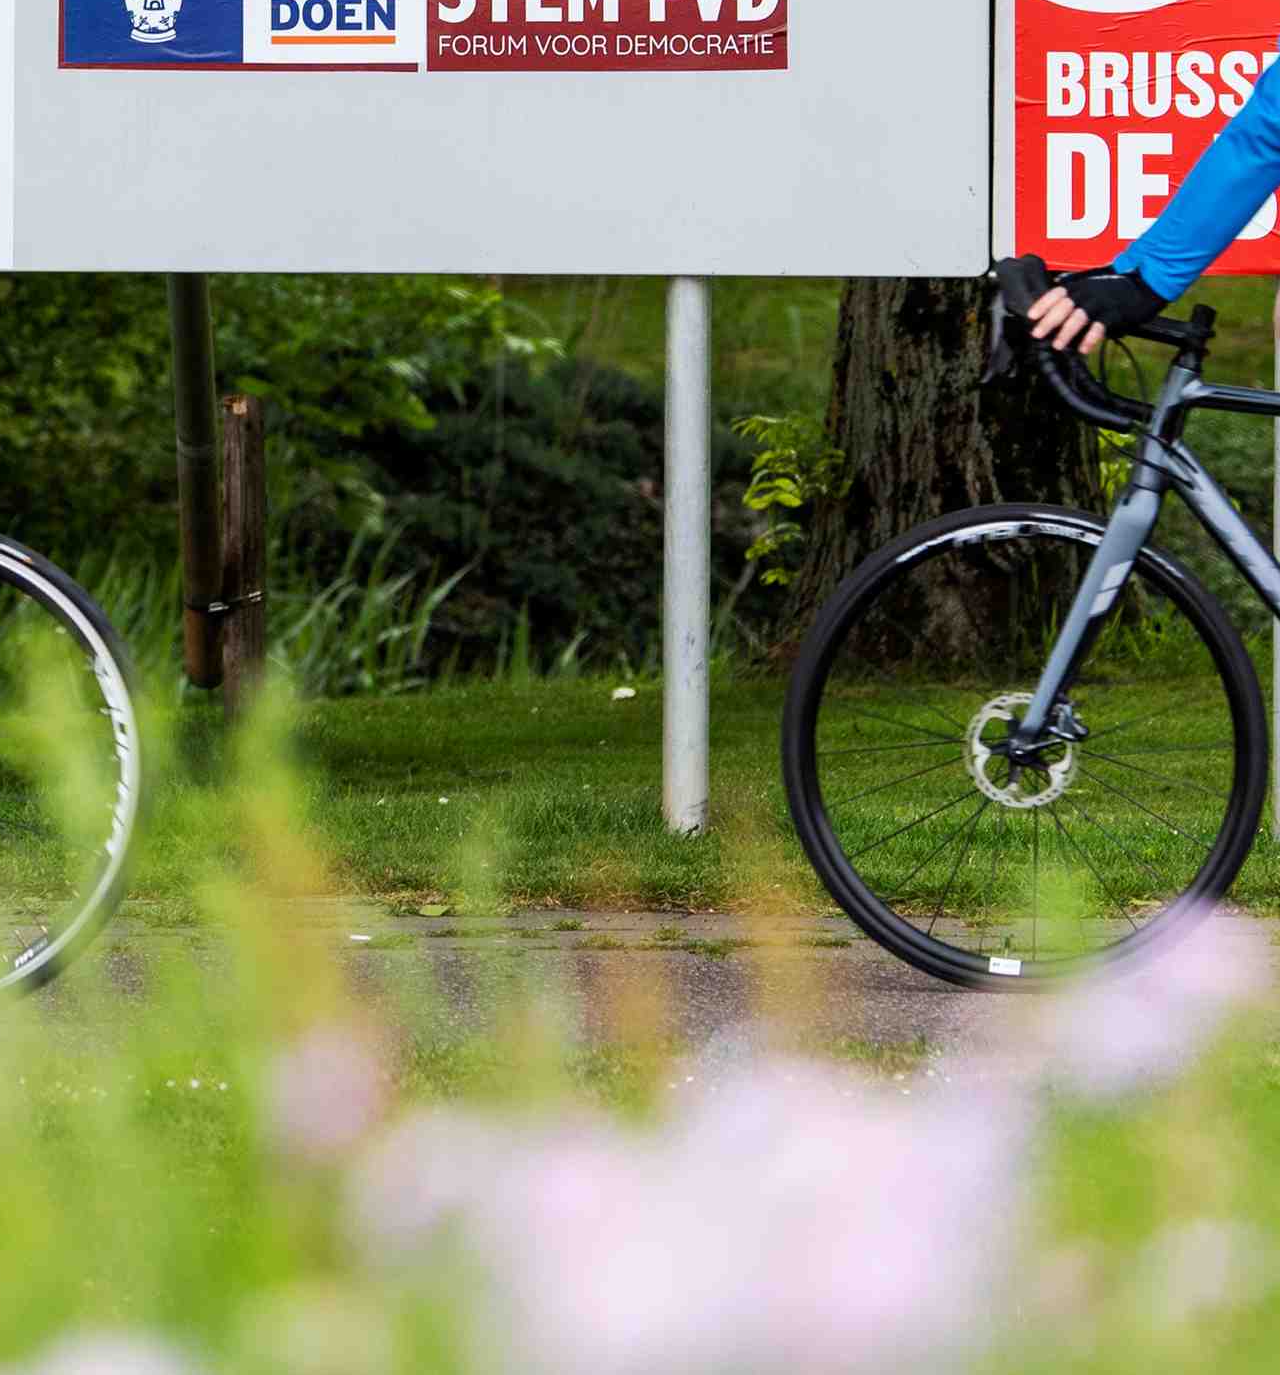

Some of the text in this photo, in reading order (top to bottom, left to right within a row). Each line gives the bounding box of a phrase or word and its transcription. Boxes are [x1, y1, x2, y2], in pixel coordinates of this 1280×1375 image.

[438, 32, 775, 57] FORUM VOOR DEMOCRATIE
[1046, 131, 1176, 241] DE
